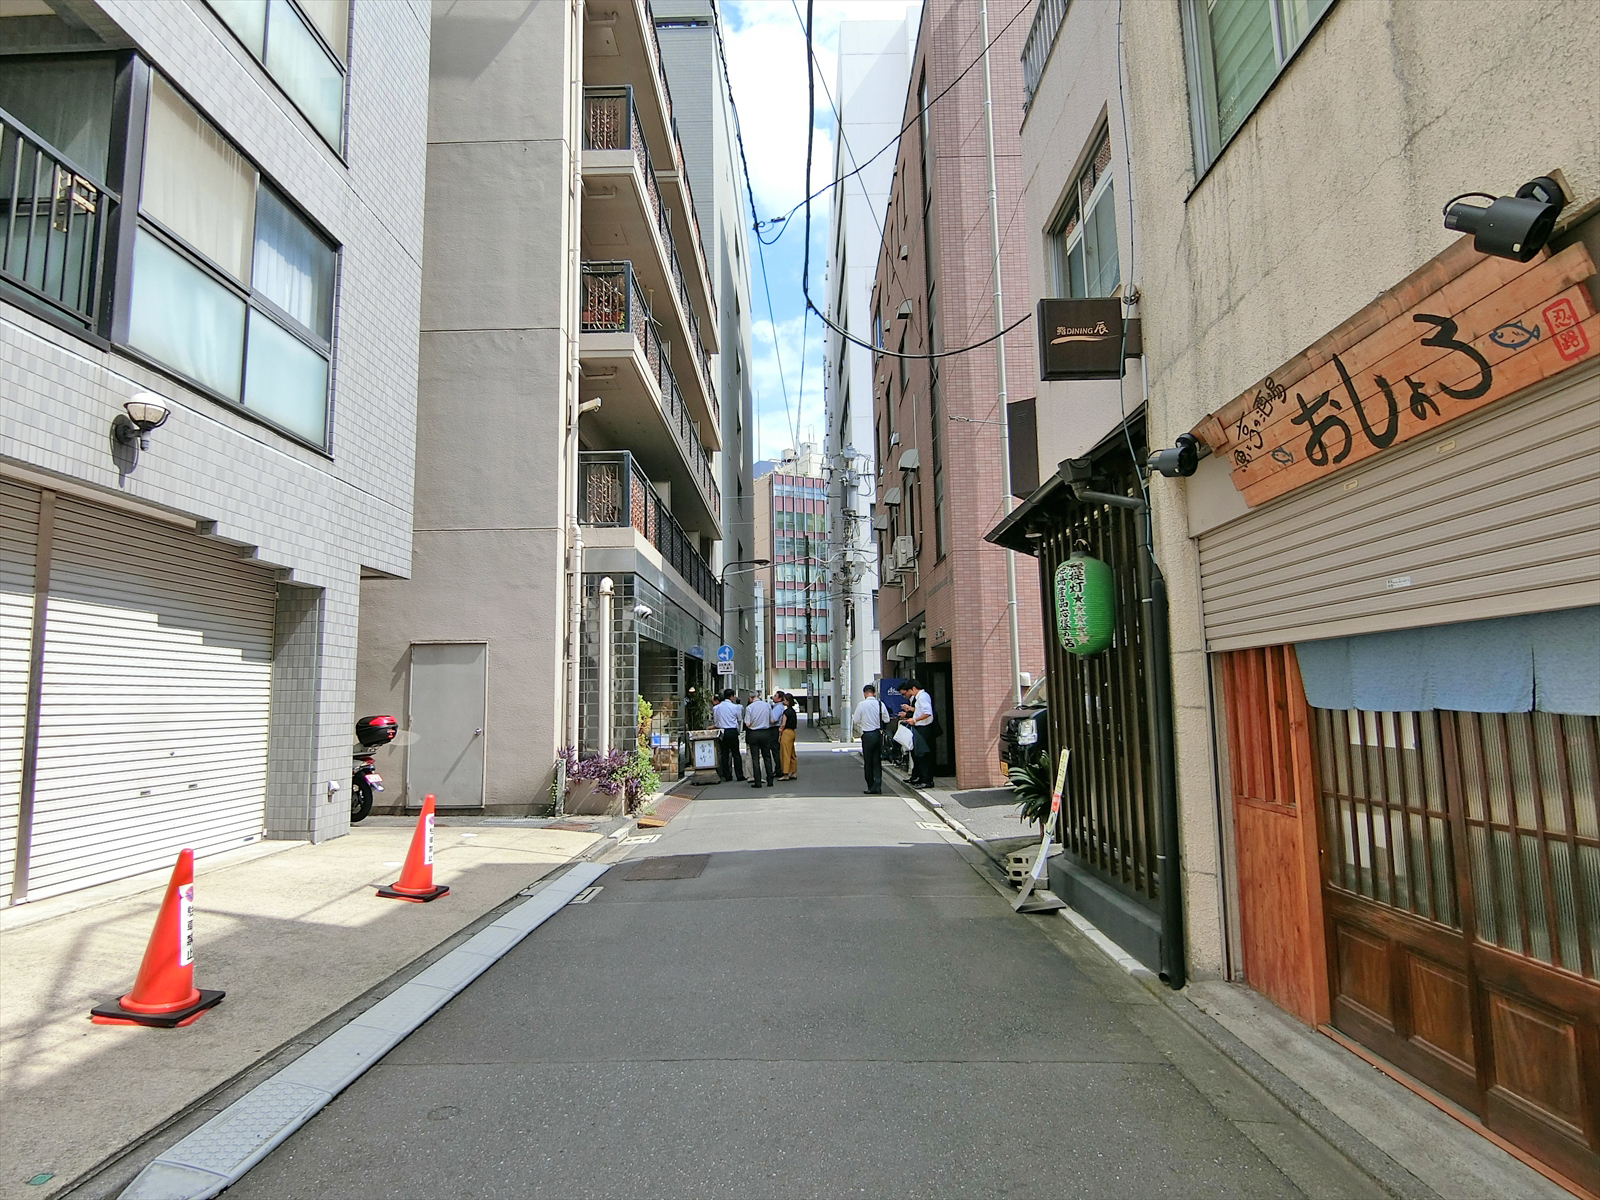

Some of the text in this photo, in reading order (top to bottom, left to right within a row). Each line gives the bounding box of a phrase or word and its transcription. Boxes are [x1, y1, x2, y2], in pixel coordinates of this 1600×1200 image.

[1291, 313, 1492, 467] おしょろ
[1067, 561, 1085, 594] 緑提灯
